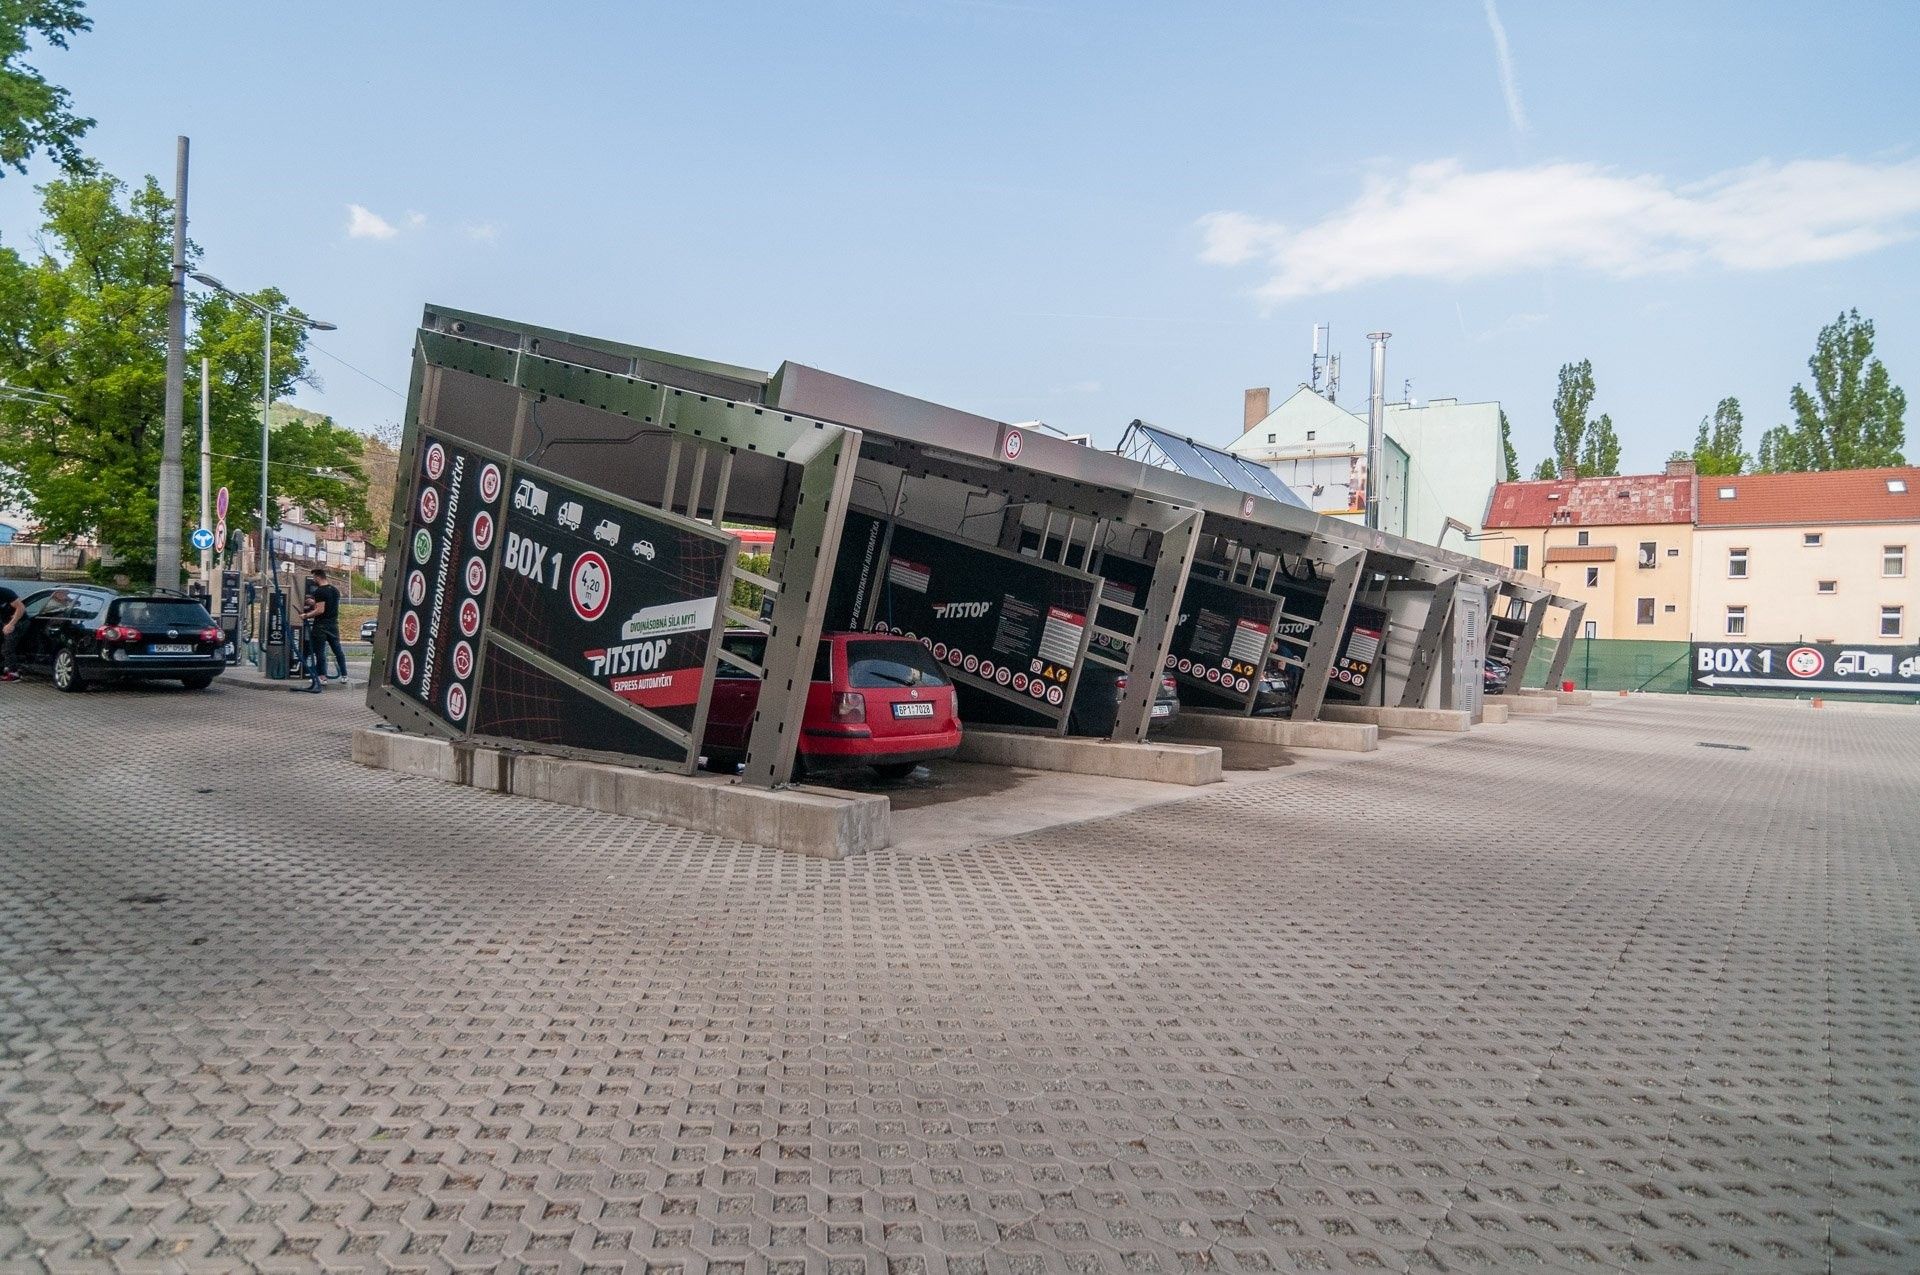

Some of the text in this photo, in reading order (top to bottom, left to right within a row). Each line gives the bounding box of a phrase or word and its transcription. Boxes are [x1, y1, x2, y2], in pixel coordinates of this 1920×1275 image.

[505, 531, 563, 590] BOX 1
[420, 638, 436, 700] NONSTOP
[430, 536, 452, 638] BEZKONTAKTNÍ
[445, 455, 465, 539] AUTOMYČKA
[932, 601, 990, 619] PITSTOP
[586, 639, 667, 676] PITSTOP
[1698, 647, 1771, 673] BOX 1
[614, 680, 638, 692] EXPRESS
